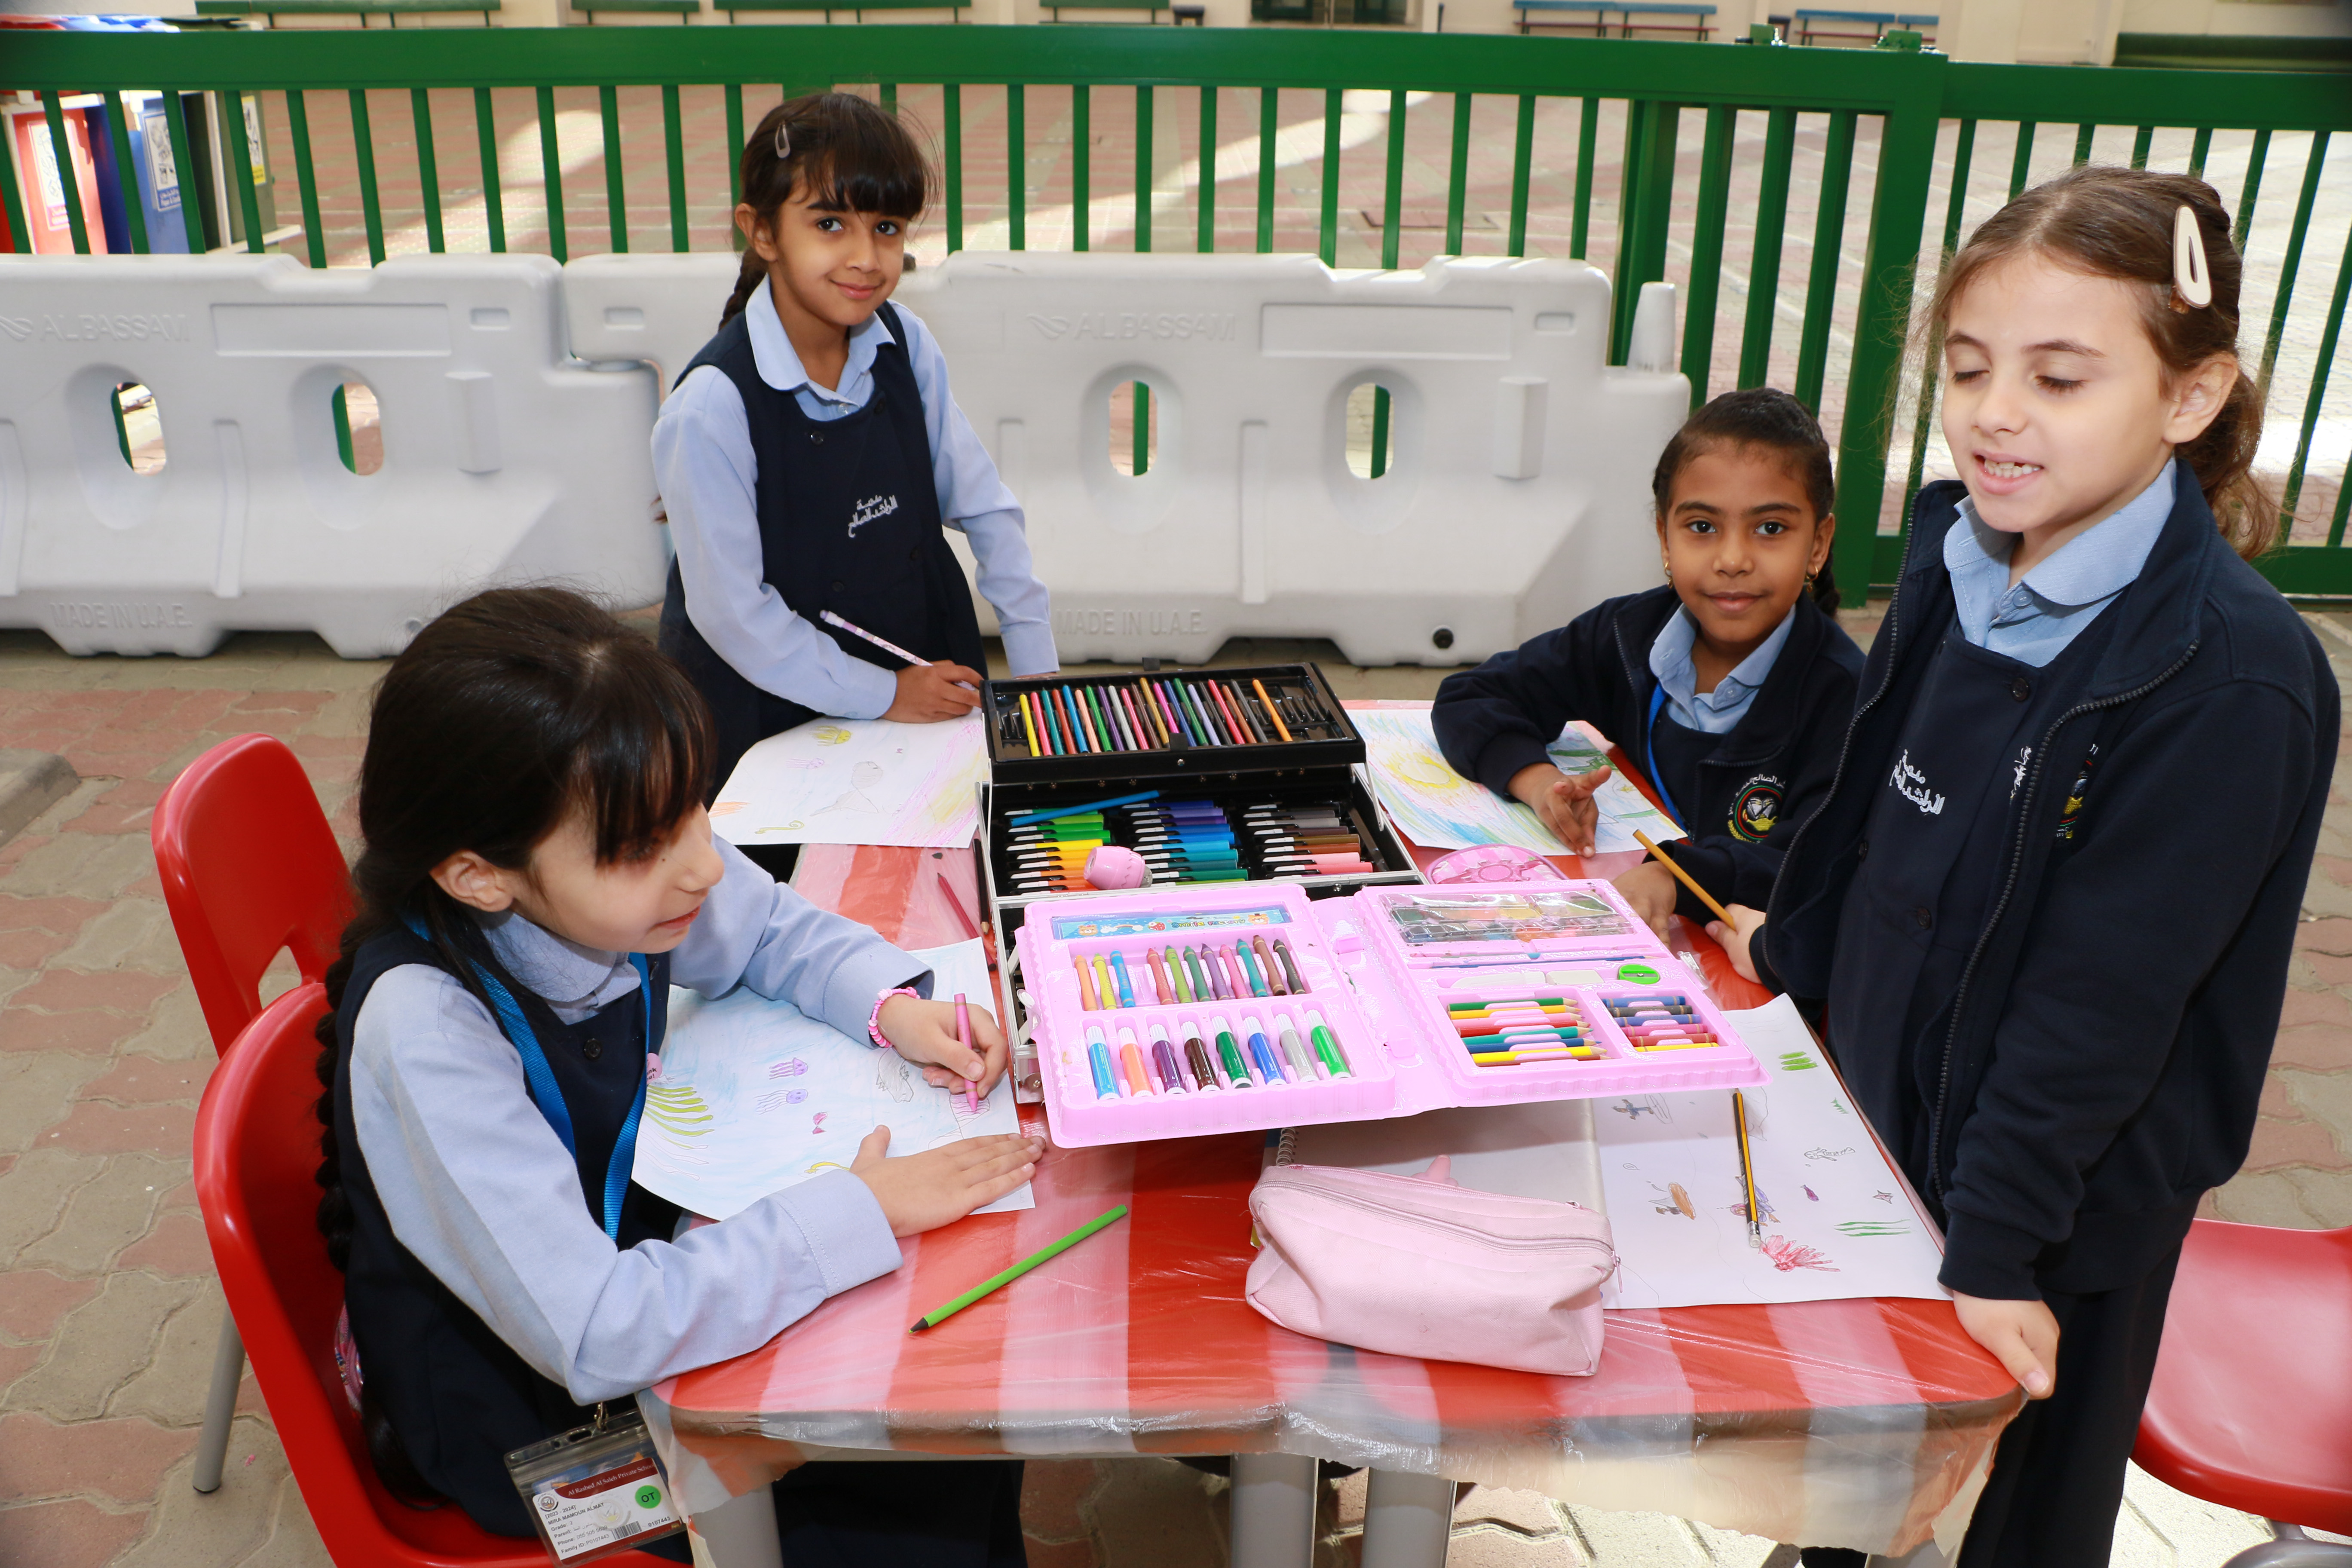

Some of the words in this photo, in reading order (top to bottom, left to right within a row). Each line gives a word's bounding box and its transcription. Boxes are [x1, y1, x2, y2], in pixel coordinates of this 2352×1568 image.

[49, 603, 107, 628] MADE
[110, 603, 133, 628] IN
[135, 603, 193, 629] U.A.E.
[1055, 609, 1115, 635] MADE
[1122, 609, 1142, 635] IN
[1149, 609, 1207, 636] U.A.E.
[1752, 773, 1777, 785] الصالح
[575, 1483, 595, 1493] Rashed
[618, 1470, 637, 1479] Private
[641, 1492, 655, 1503] OT
[545, 1511, 559, 1519] [2023
[562, 1509, 586, 1520] MAMOUN
[587, 1503, 604, 1512] ALMAT
[551, 1523, 567, 1531] Grade:
[648, 1516, 671, 1527] 0107443
[554, 1530, 571, 1538] Parent:
[557, 1537, 575, 1546] Phone:
